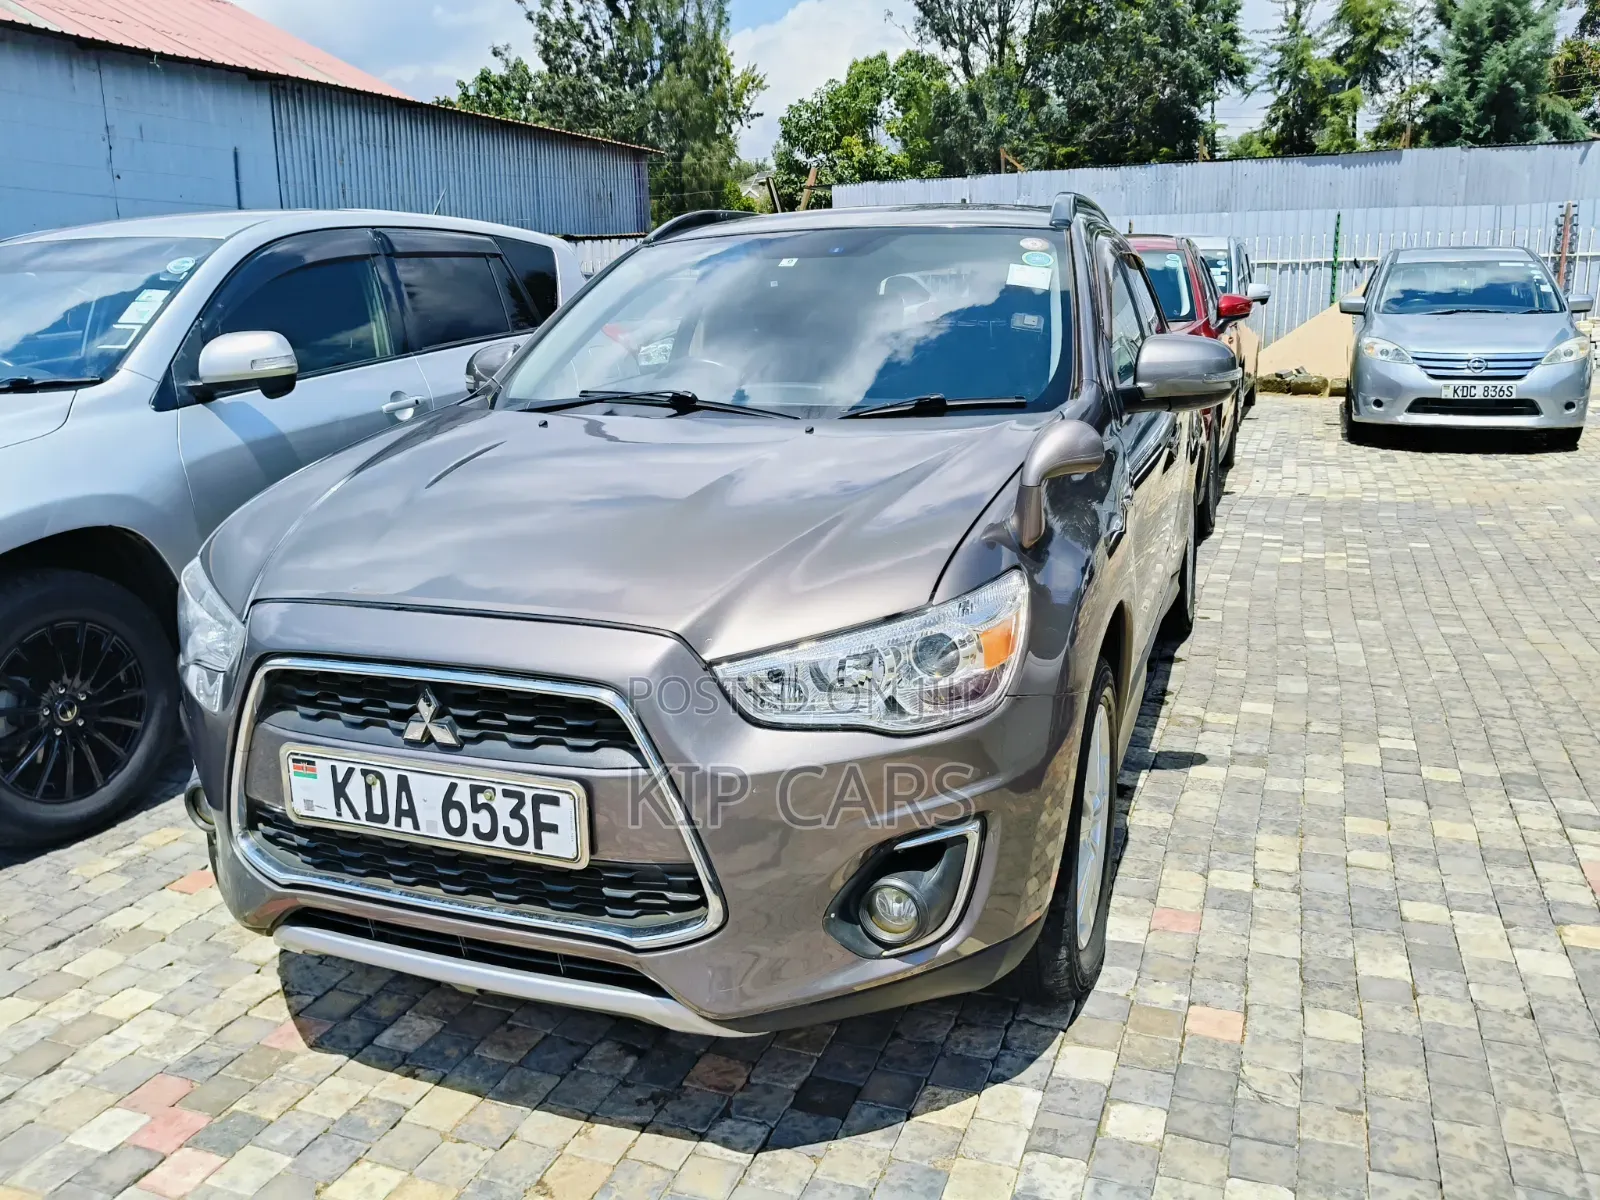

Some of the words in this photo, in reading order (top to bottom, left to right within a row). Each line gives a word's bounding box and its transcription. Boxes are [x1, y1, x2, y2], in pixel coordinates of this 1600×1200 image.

[1452, 385, 1477, 398] KDC
[1482, 385, 1514, 398] 836S
[330, 764, 421, 832] KDA
[441, 781, 561, 851] 653F
